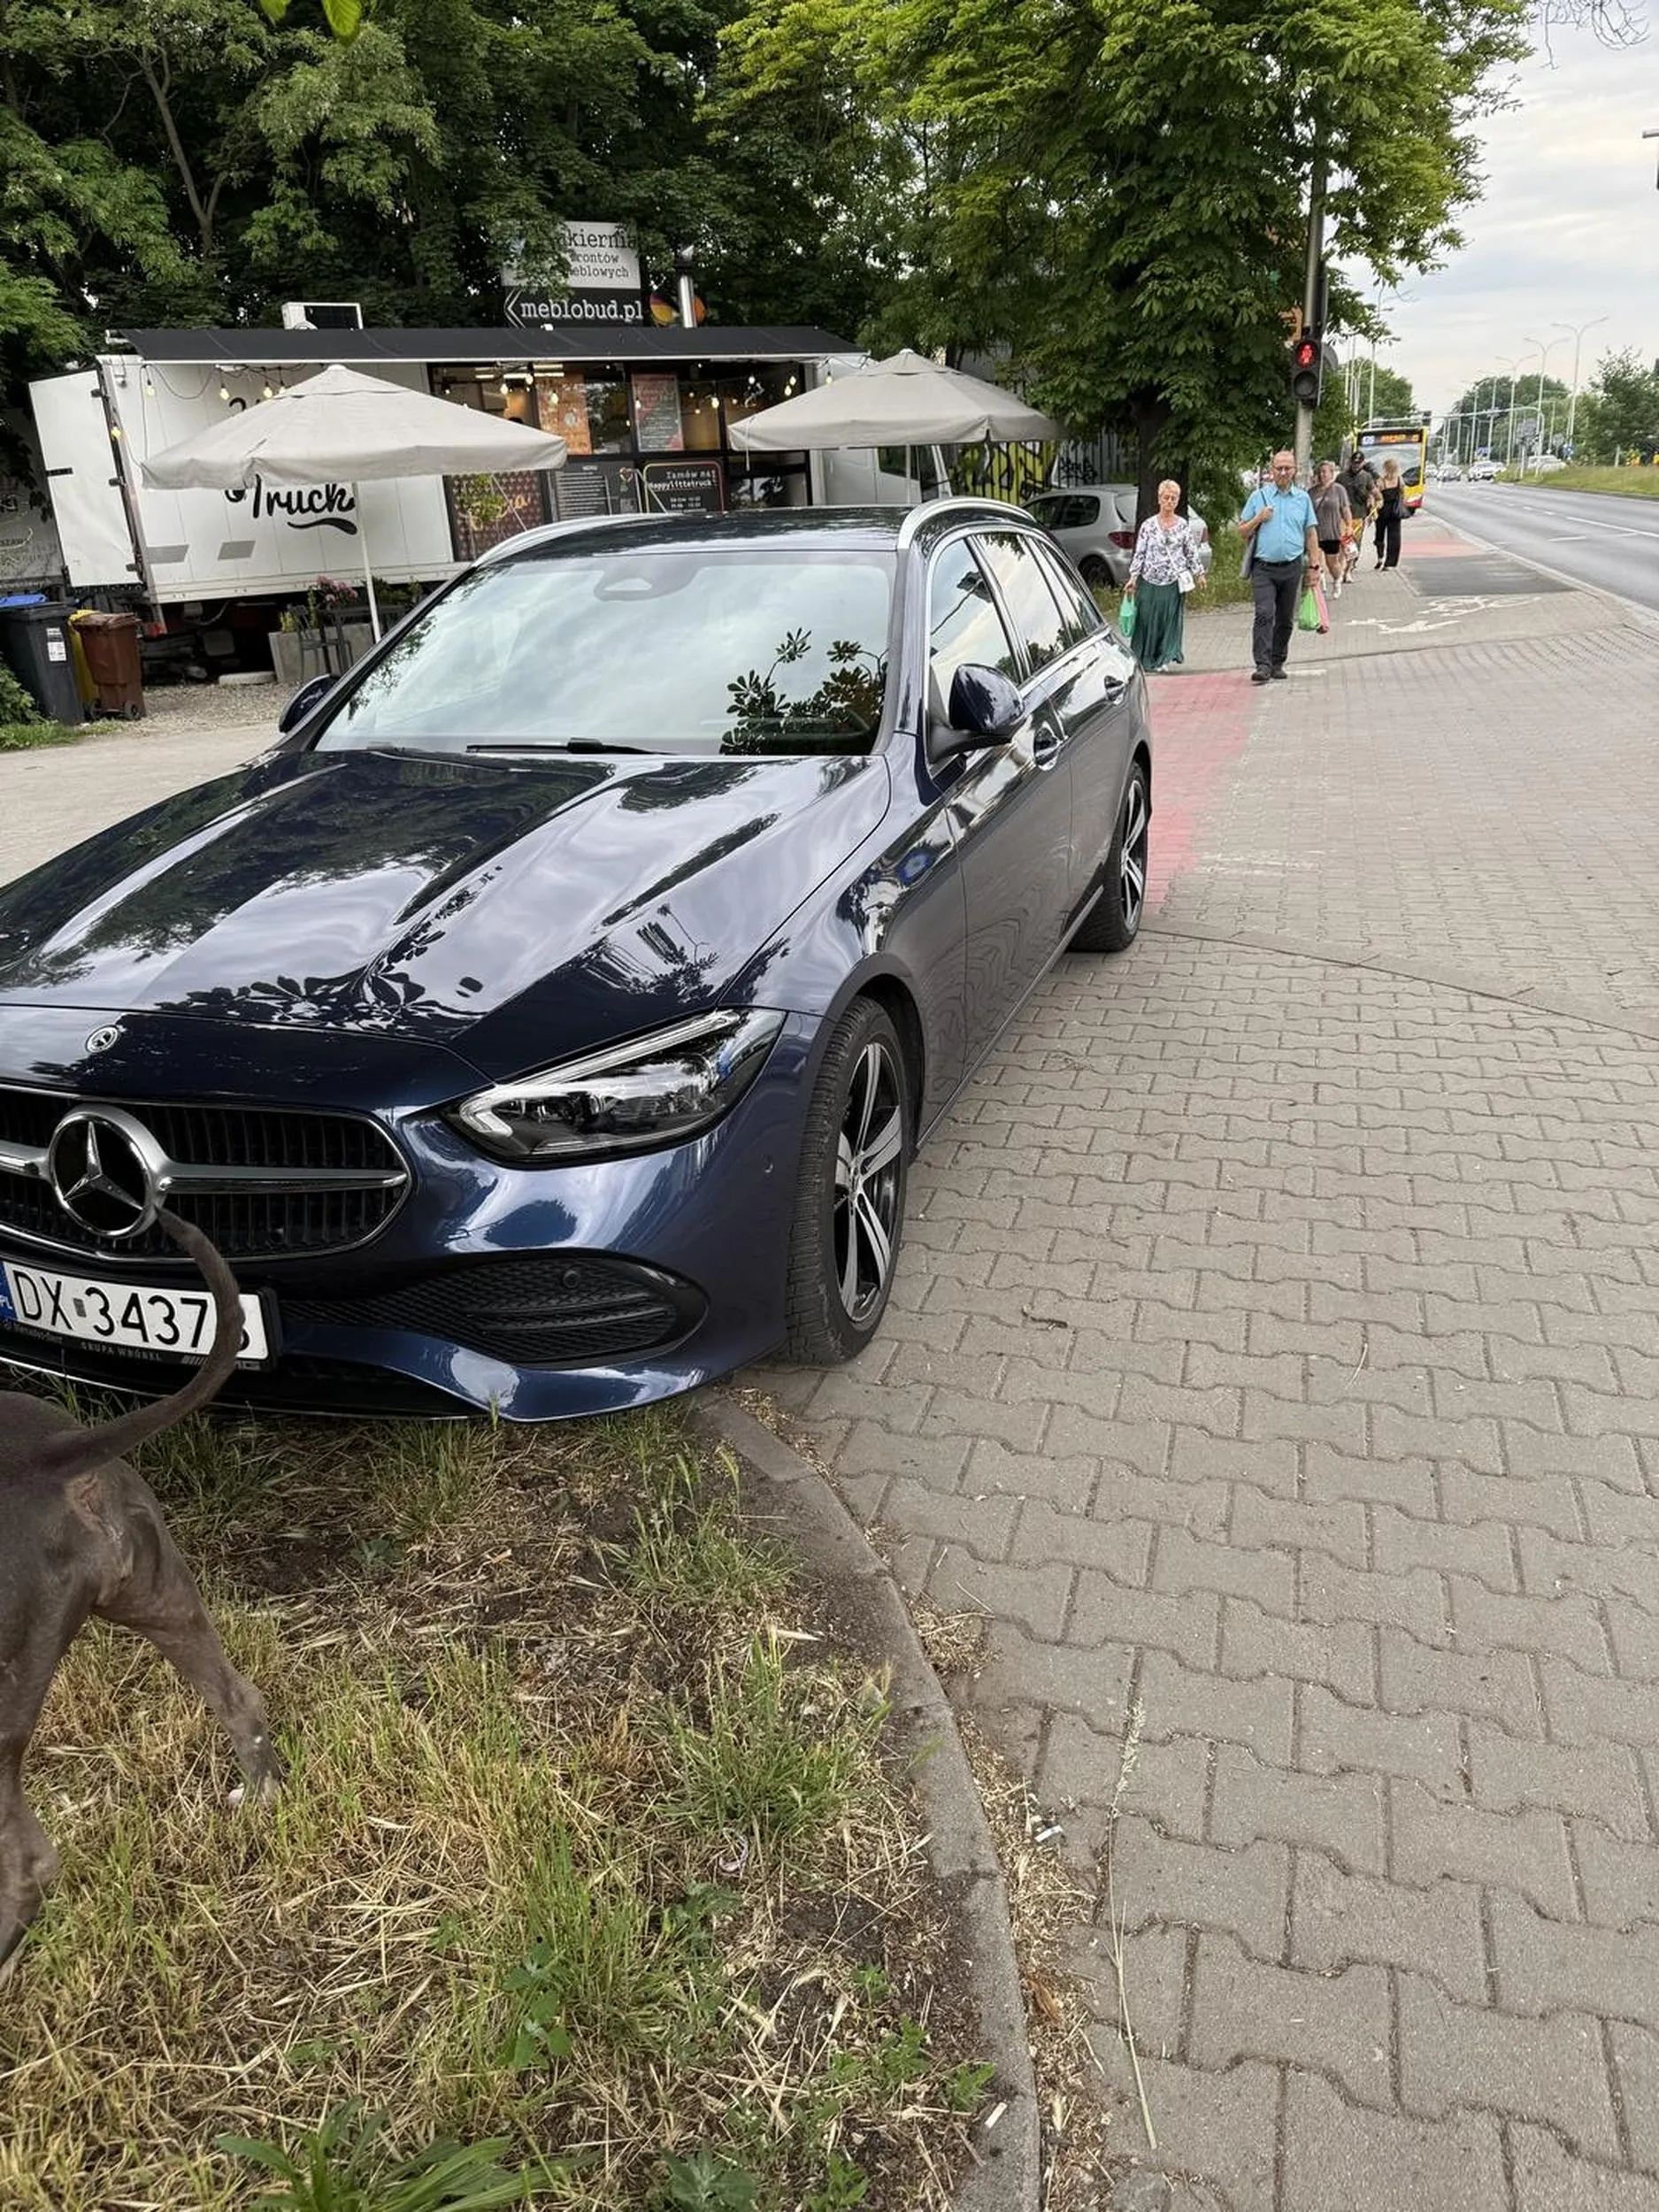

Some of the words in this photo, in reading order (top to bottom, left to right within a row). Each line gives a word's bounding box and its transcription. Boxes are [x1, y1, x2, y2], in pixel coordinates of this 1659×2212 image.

[520, 300, 643, 322] meblobud.pl
[12, 1270, 73, 1330] DX
[84, 1286, 250, 1352] 3437
